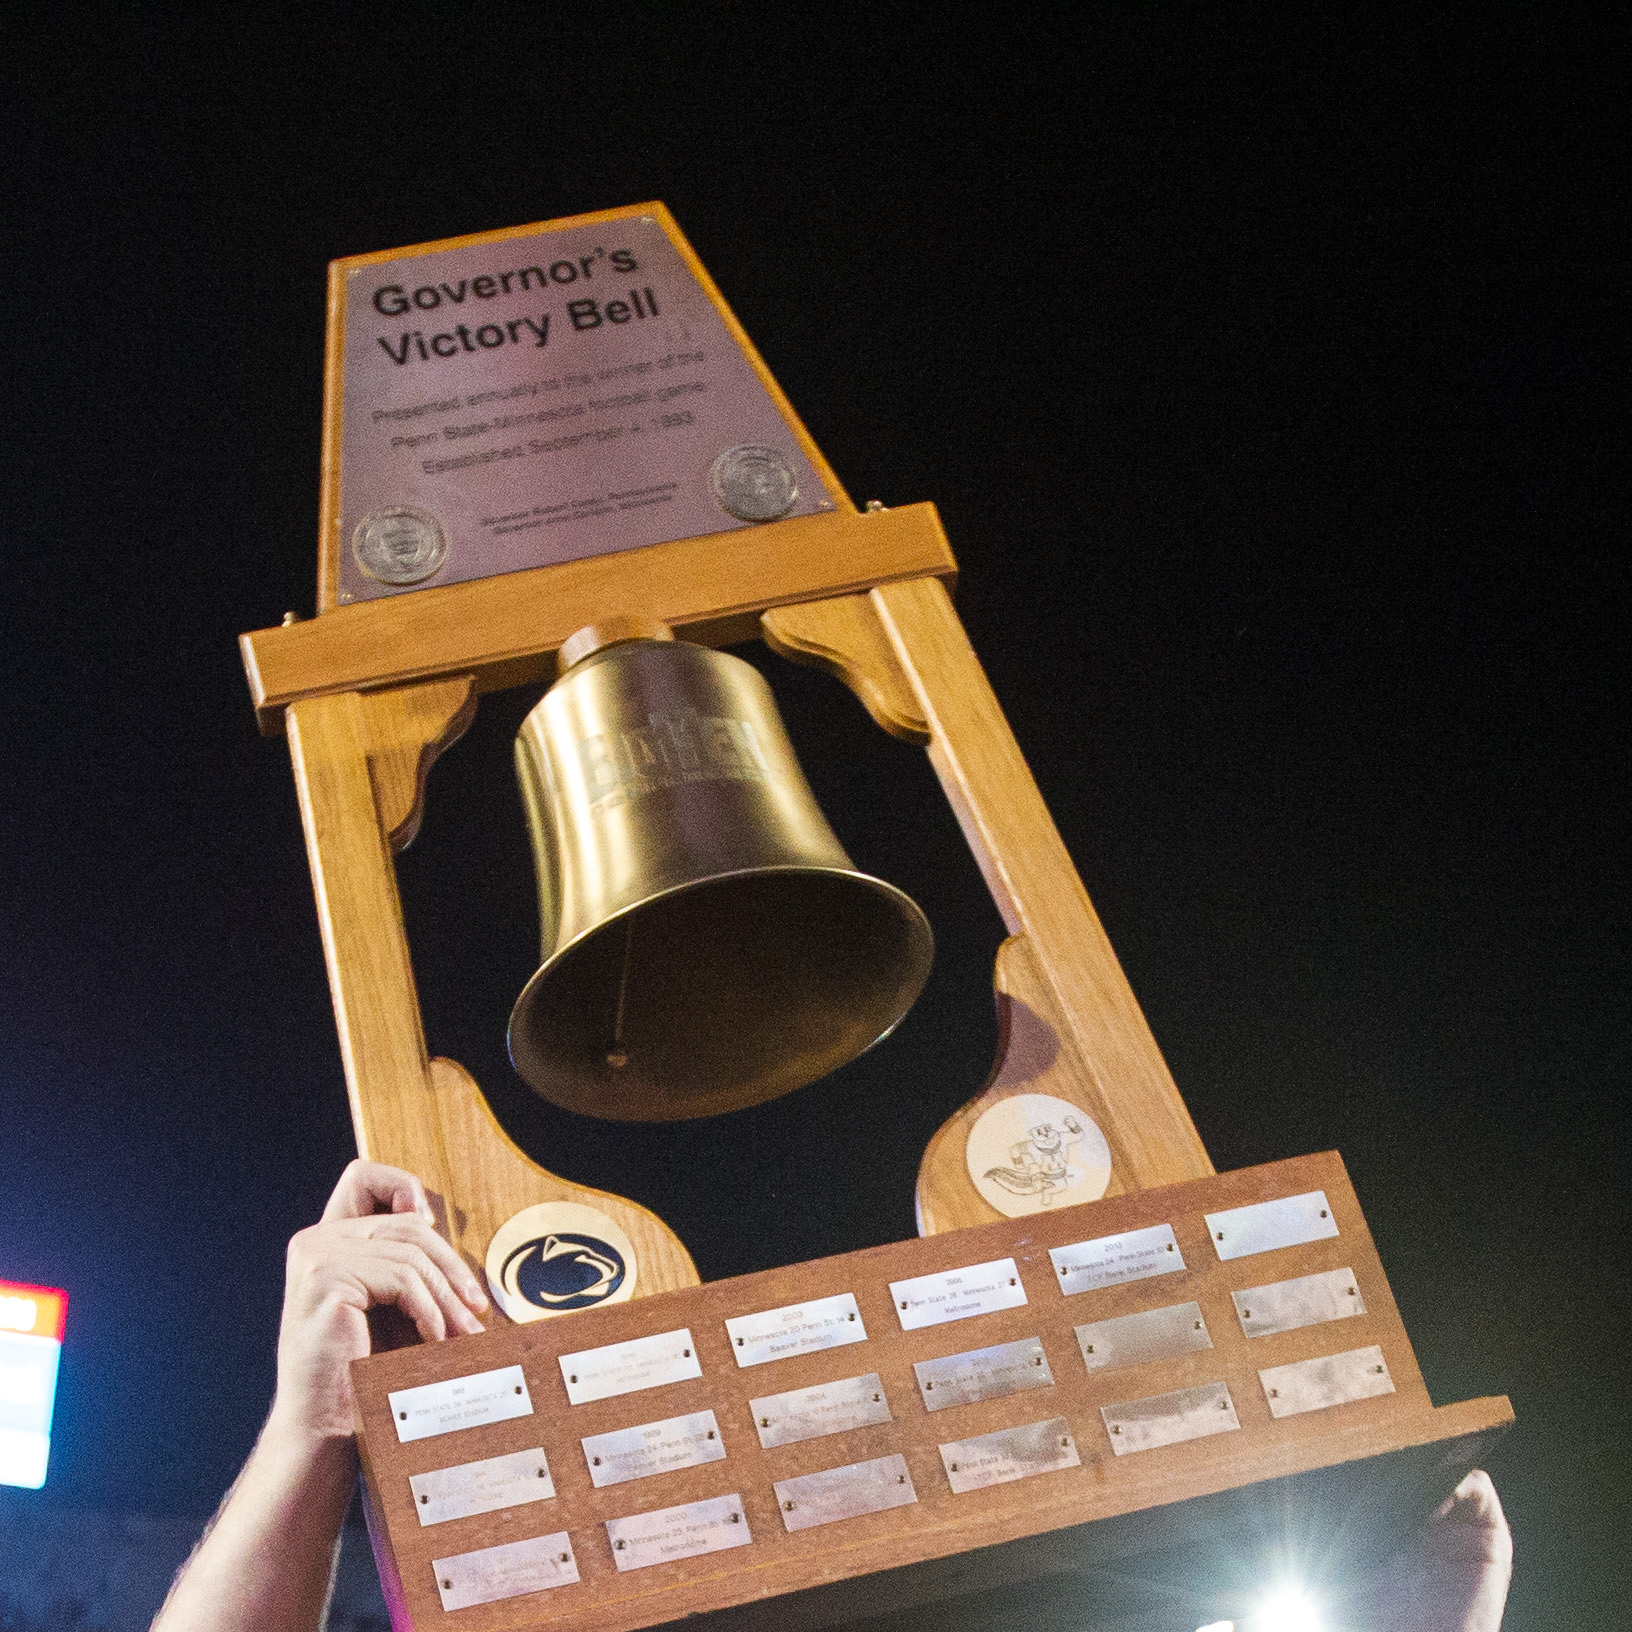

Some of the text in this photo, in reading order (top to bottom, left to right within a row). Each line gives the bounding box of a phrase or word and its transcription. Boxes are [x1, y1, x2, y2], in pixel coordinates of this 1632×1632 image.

[373, 248, 638, 317] Governor's
[378, 288, 659, 365] Victory Bell
[372, 395, 461, 424] Presented
[466, 383, 539, 409] annually
[391, 429, 437, 450] Penn
[653, 380, 710, 403] game
[422, 443, 525, 474] Established
[527, 424, 626, 455] September
[1070, 1259, 1104, 1272] Minnesota
[1118, 1252, 1136, 1262] Penn
[1136, 1247, 1155, 1257] State
[1125, 1260, 1157, 1273] Stadium
[909, 1297, 926, 1306] Penn
[927, 1293, 946, 1303] State
[943, 1300, 981, 1314] Metrodome
[781, 1310, 804, 1321] 2003
[747, 1328, 788, 1343] Minnesota
[788, 1325, 800, 1334] 20
[801, 1320, 822, 1330] Penn
[769, 1332, 832, 1352] Beaver Stadium
[604, 1446, 645, 1462] Minnesota
[659, 1438, 681, 1449] Penn
[627, 1449, 691, 1471] Beaver Stadium
[664, 1511, 688, 1523] 2000
[628, 1530, 670, 1546] Minnesota
[685, 1521, 707, 1533] Penn
[659, 1536, 707, 1554] Metrodome
